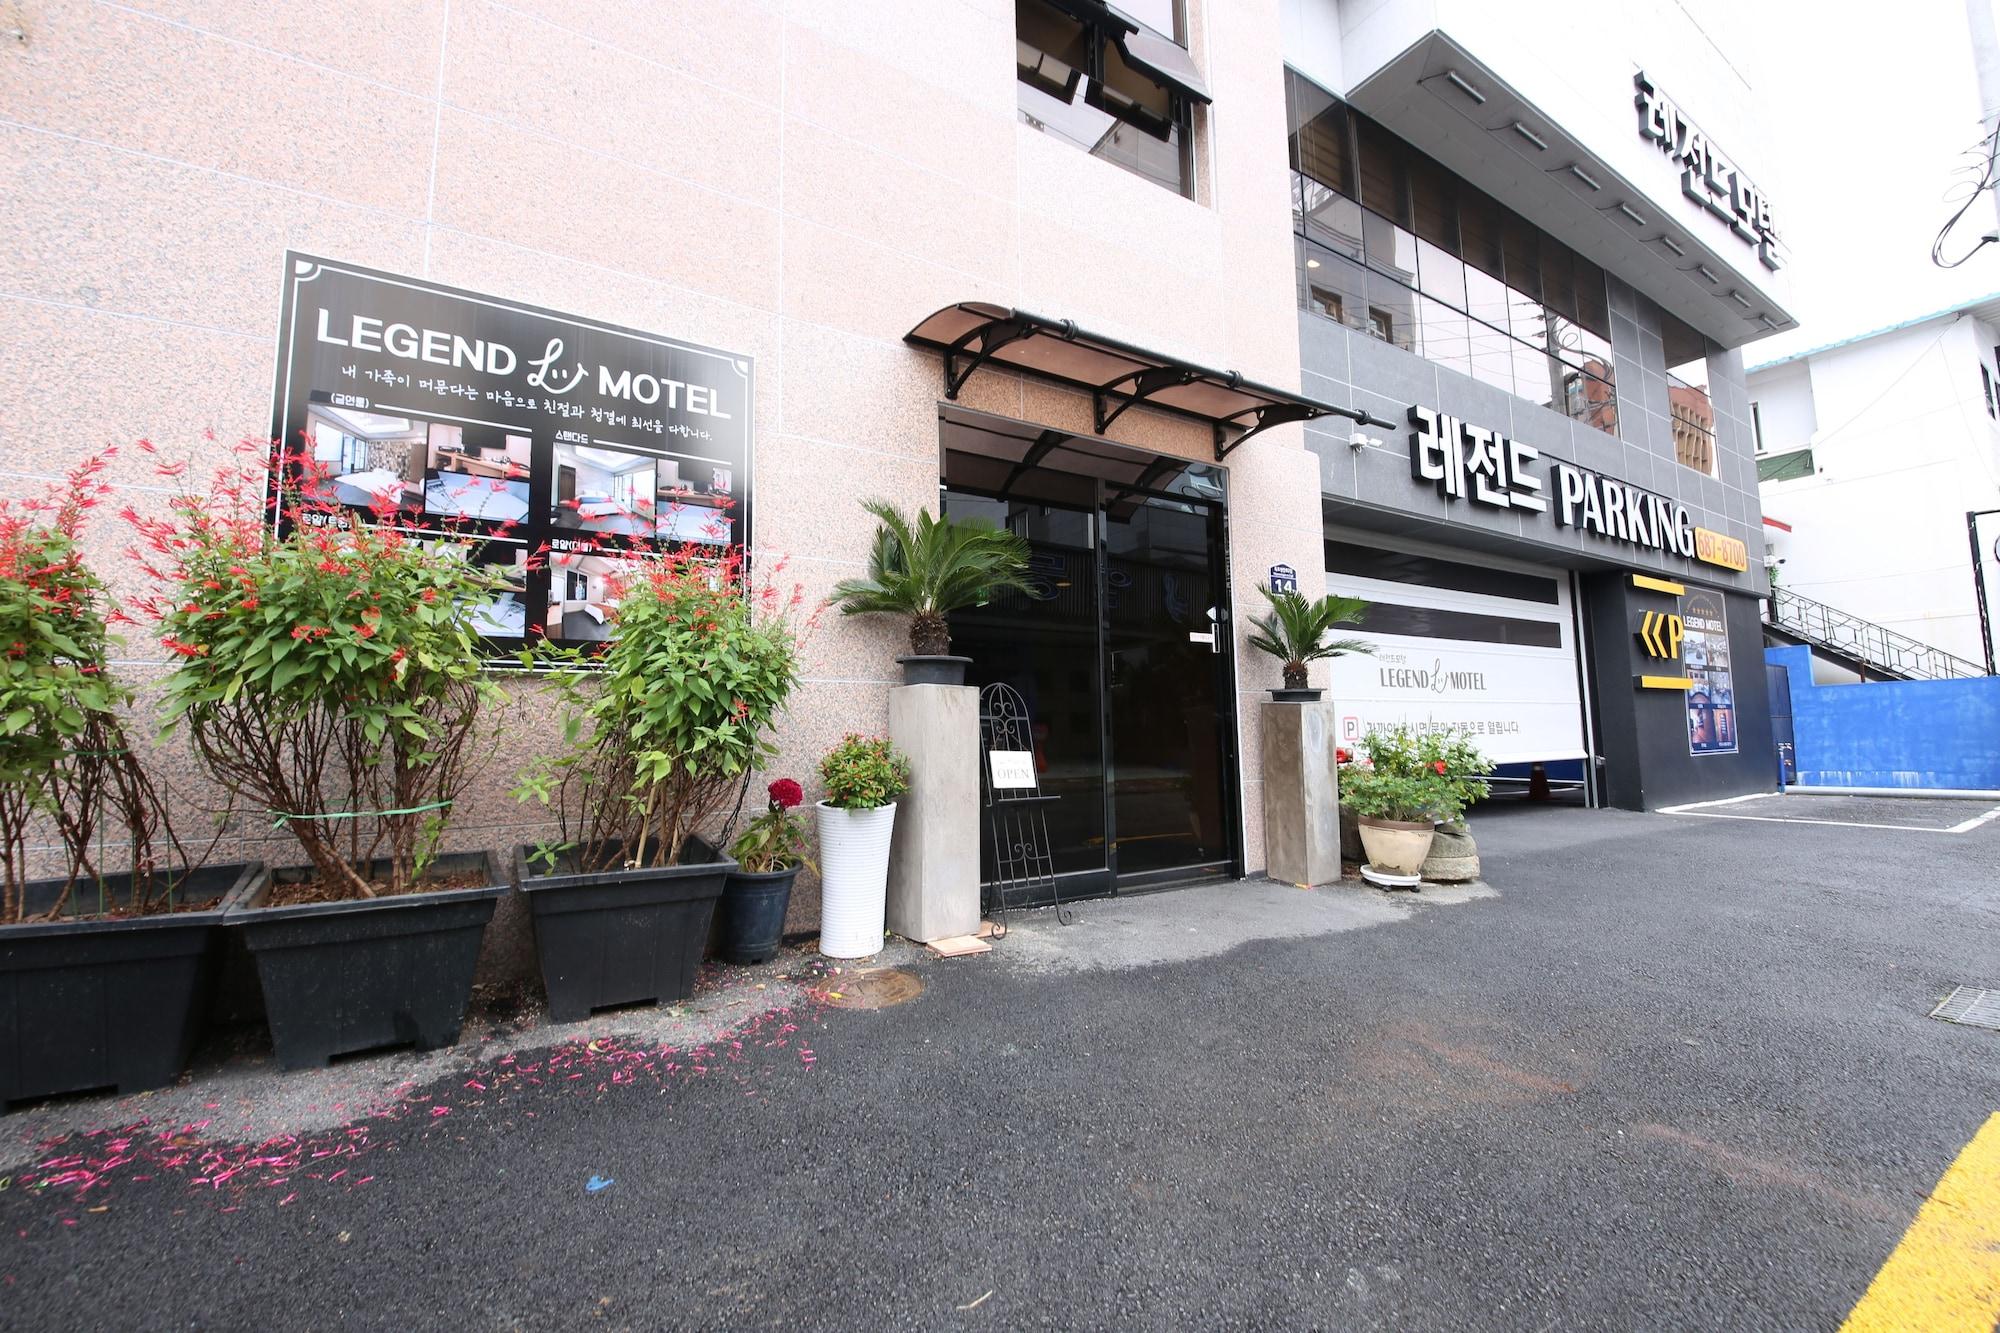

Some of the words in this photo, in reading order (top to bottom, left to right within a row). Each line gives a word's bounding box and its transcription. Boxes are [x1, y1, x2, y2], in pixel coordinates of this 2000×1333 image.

[317, 308, 518, 376] LEGEND
[598, 365, 732, 420] MOTEL
[342, 364, 357, 380] 내
[364, 369, 411, 389] 가족이
[418, 378, 480, 402] 머문다는
[486, 389, 538, 411] 마음으로
[543, 398, 586, 420] 친절과
[590, 406, 627, 427] 청결에
[631, 417, 664, 435] 최선을
[1411, 404, 1547, 514] 레전드
[1557, 464, 1696, 559] PARKING
[1697, 531, 1745, 568] 687-8700
[1682, 614, 1706, 630] LEGEND
[1705, 619, 1724, 633] MOTEL
[1380, 667, 1429, 689] LEGEND
[1449, 671, 1487, 691] MOTEL
[1346, 721, 1355, 737] P
[997, 768, 1030, 779] OPEN
